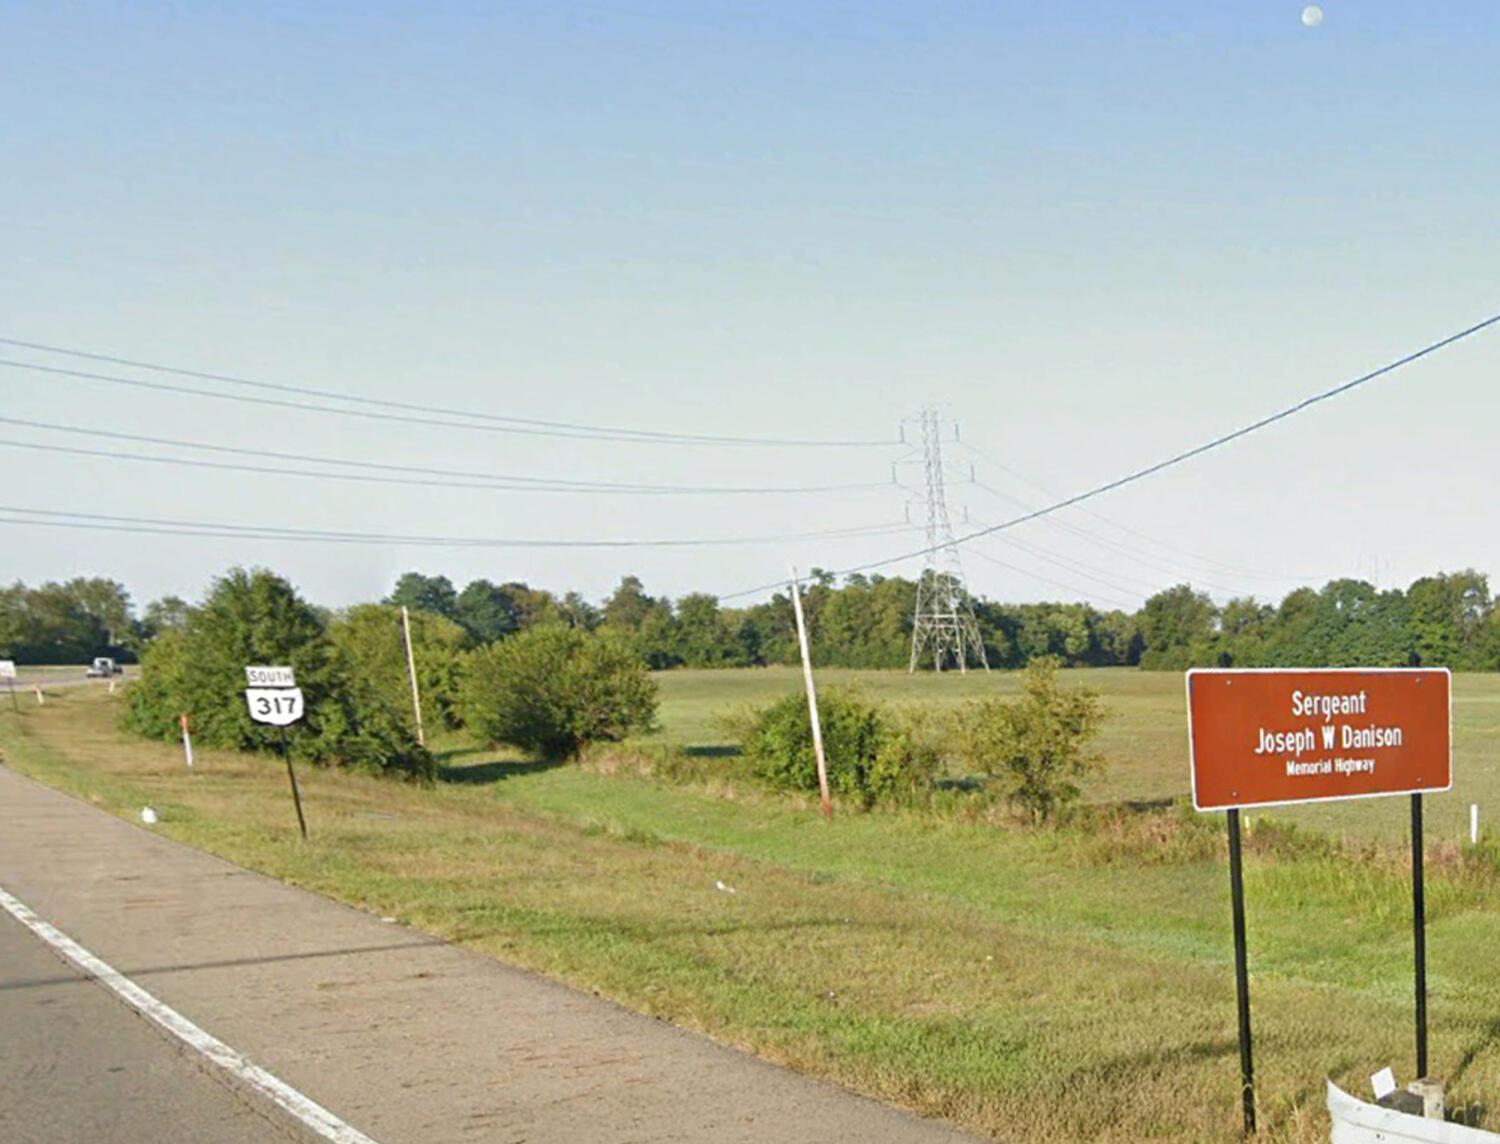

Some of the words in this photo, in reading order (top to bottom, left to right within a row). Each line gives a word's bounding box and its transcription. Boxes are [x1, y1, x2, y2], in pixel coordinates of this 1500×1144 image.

[249, 670, 292, 683] SOUTH
[256, 696, 297, 715] 317
[1292, 690, 1366, 722] Sergeant
[1254, 727, 1315, 757] Joseph
[1321, 725, 1336, 750] W
[1342, 724, 1403, 749] Danison
[1286, 759, 1332, 776] Memorial
[1334, 758, 1375, 776] Highway
